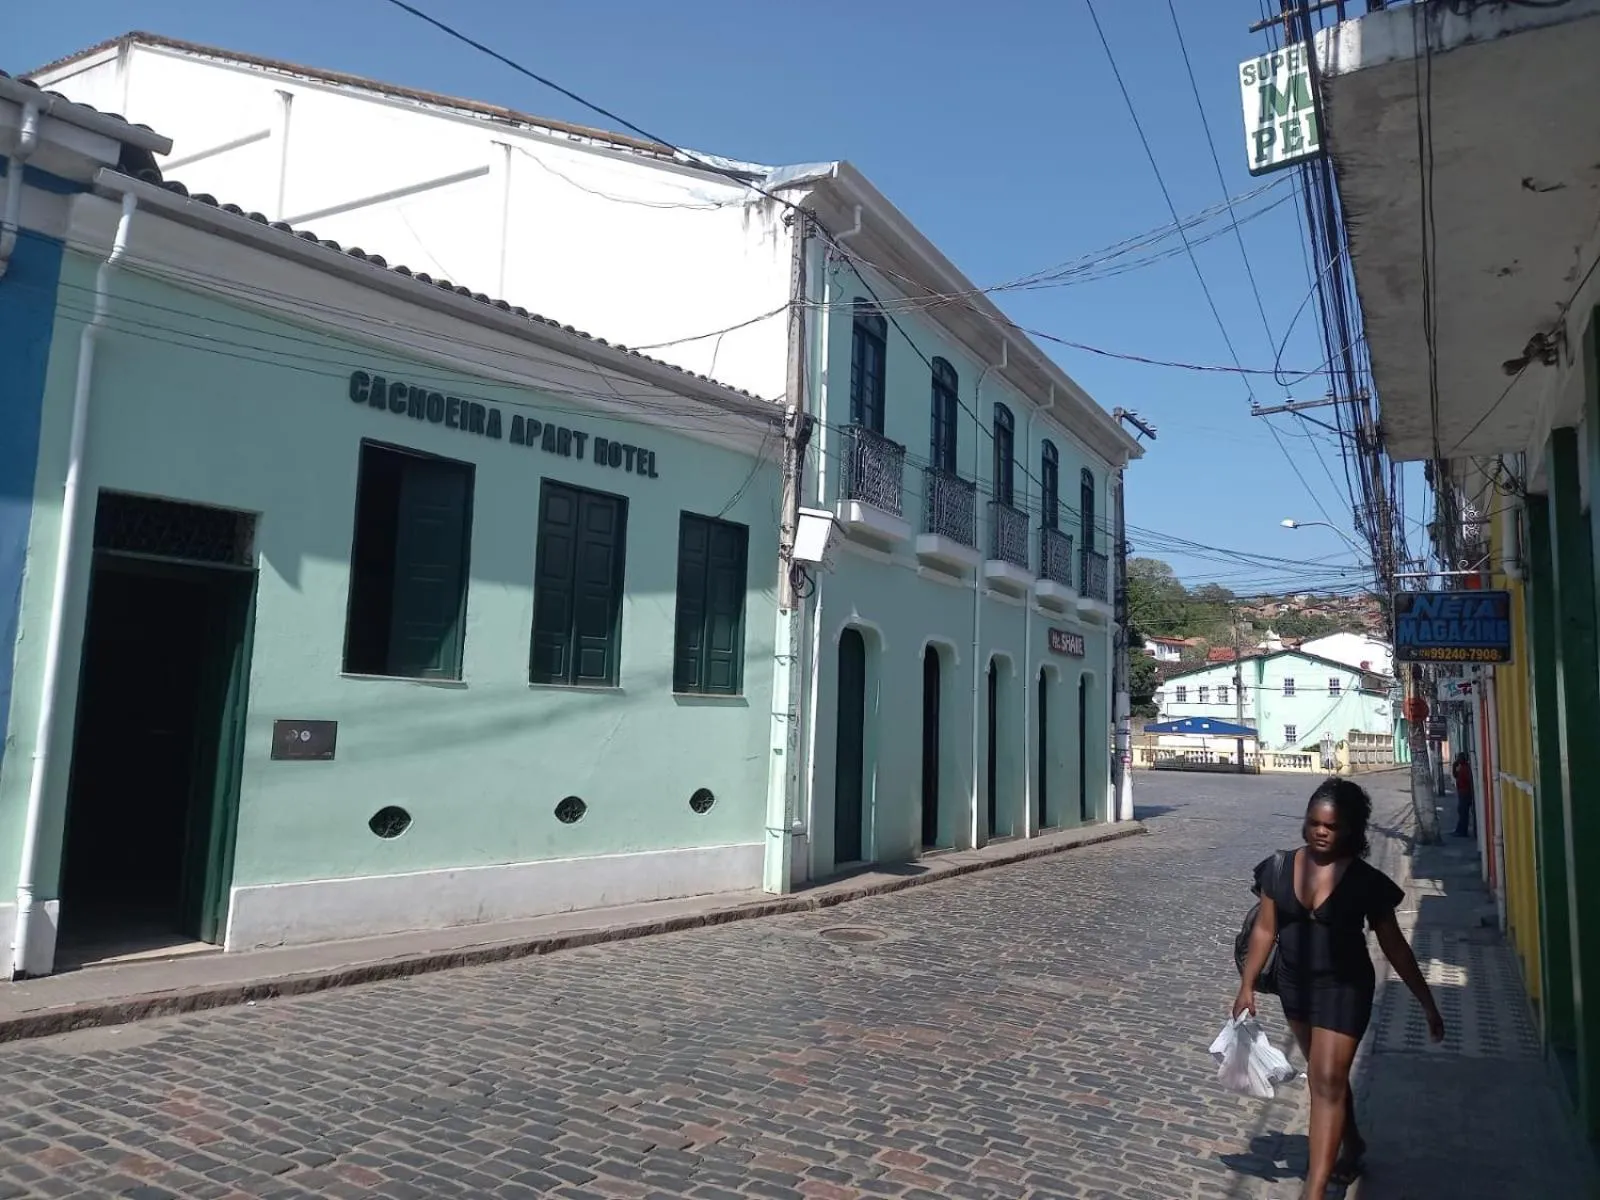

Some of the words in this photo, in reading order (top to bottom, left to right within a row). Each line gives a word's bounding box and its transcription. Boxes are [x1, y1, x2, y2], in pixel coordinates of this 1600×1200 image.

[349, 370, 502, 438] CACHOEIRA
[510, 415, 588, 460] APART
[595, 437, 658, 478] HOTEL
[1399, 619, 1508, 644] MAGAZINE
